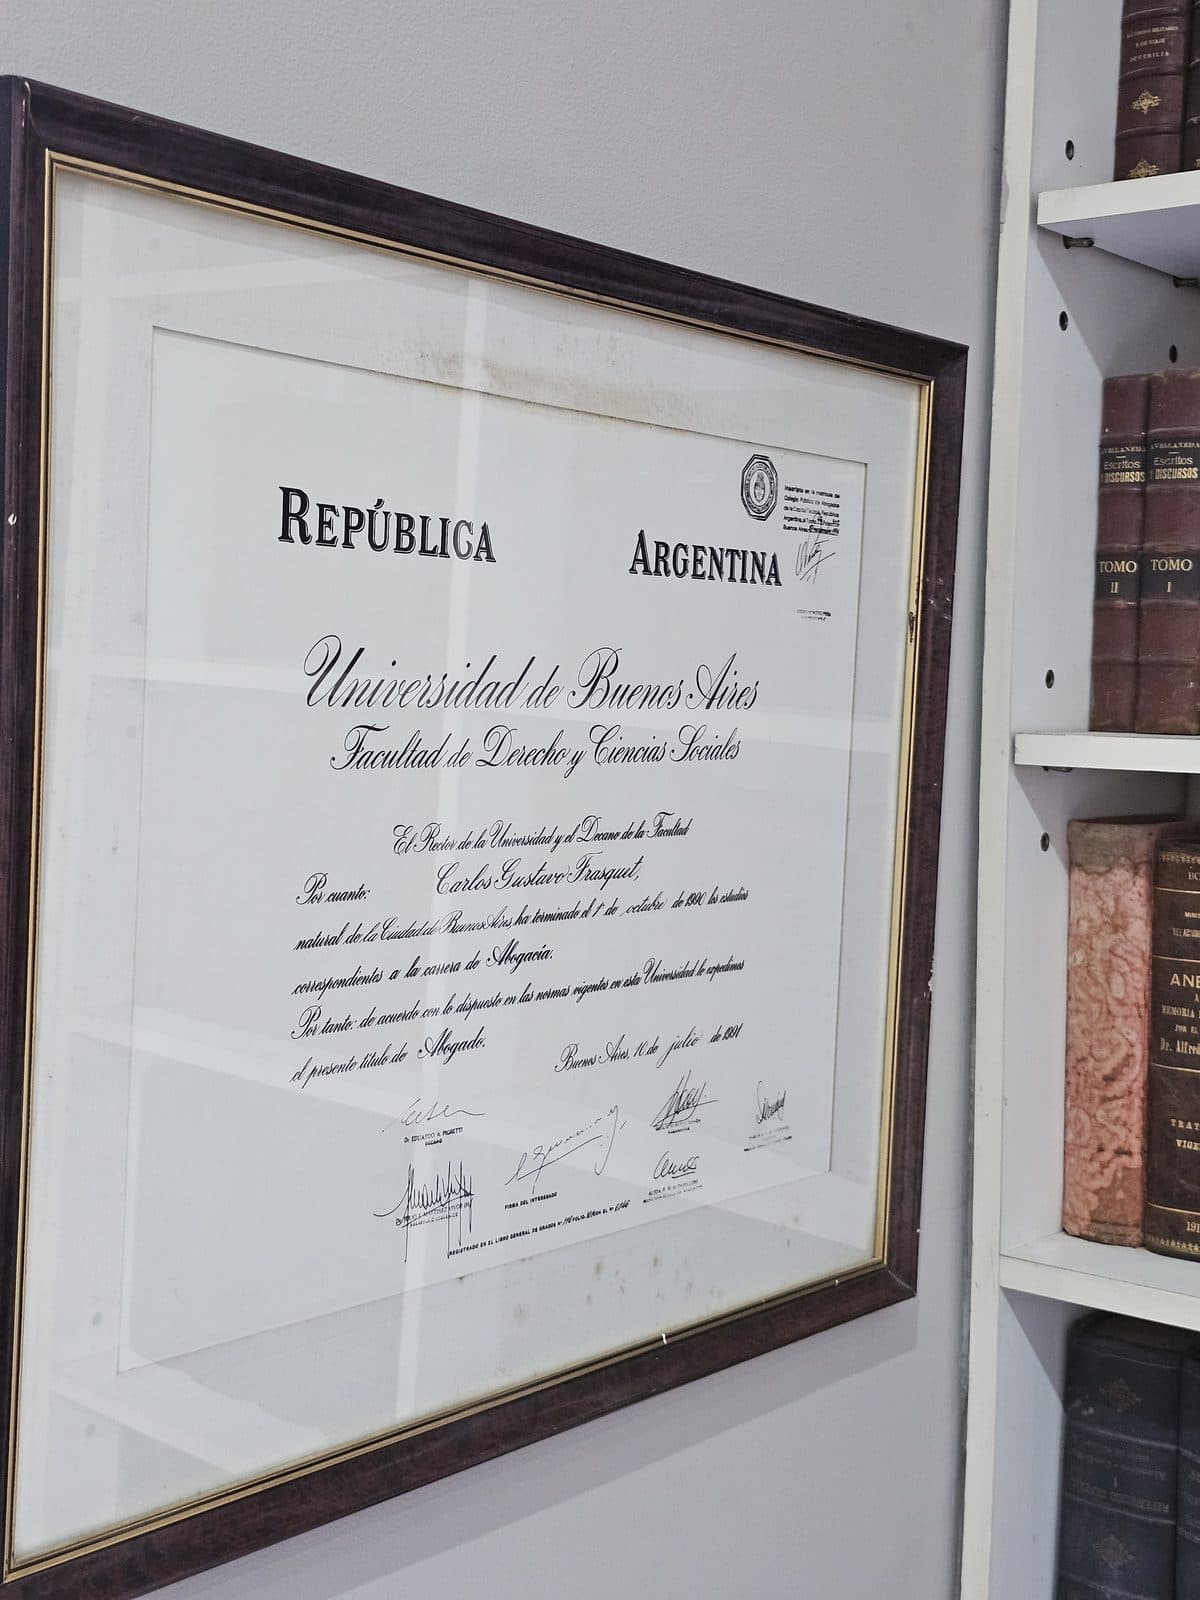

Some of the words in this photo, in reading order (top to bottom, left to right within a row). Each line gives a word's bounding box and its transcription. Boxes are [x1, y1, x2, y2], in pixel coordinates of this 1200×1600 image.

[1103, 460, 1141, 470] Escritos
[1153, 456, 1193, 466] Escritos
[1105, 471, 1145, 484] DISCURSOS
[1155, 467, 1198, 479] DISCURSOS
[278, 486, 496, 562] REPÚBLICA
[629, 529, 782, 586] ARGENTINA
[1099, 560, 1137, 573] TOMO
[1151, 558, 1193, 571] TOMO
[1111, 581, 1118, 593] II
[1167, 581, 1172, 593] I
[303, 634, 536, 709] Universidad
[520, 664, 564, 710] de
[567, 646, 682, 710] Buenos
[685, 652, 760, 711] Aires
[330, 723, 446, 771] Facultad
[443, 737, 474, 769] de
[475, 724, 570, 770] Derecho
[564, 749, 587, 778] y
[588, 723, 668, 764] Ciencias
[669, 724, 743, 763] Sociales
[392, 824, 414, 855] El
[413, 822, 456, 853] Rector
[455, 830, 474, 850] de
[472, 829, 488, 849] la
[489, 819, 558, 850] Universidad
[551, 835, 564, 853] y
[564, 823, 581, 844] el
[576, 815, 620, 844] Decano
[619, 822, 634, 841] de
[633, 820, 646, 840] la
[646, 811, 694, 839] Facultad
[296, 872, 329, 906] Por
[324, 884, 371, 904] cuanto:
[436, 862, 493, 895] Carlos
[493, 857, 569, 890] Gustavo
[566, 850, 645, 891] Frasquet,
[293, 922, 349, 951] natural
[344, 922, 365, 945] de
[361, 922, 382, 943] la
[380, 916, 429, 941] Ciudad
[420, 919, 440, 937] de
[438, 909, 487, 935] Buenos
[511, 904, 530, 927] ha
[529, 901, 581, 925] terminado
[579, 898, 597, 919] el
[603, 897, 619, 917] de
[620, 891, 666, 918] octubre
[671, 890, 685, 910] de
[707, 886, 719, 906] los
[719, 885, 749, 904] estudios
[291, 964, 384, 1001] correspondientes
[388, 967, 401, 981] a
[404, 955, 421, 980] la
[421, 961, 463, 978] carrera
[464, 950, 482, 972] de
[486, 937, 554, 975] Abogacía.
[290, 1004, 323, 1039] Por
[320, 1014, 358, 1036] tanto:
[358, 1006, 377, 1029] de
[375, 999, 421, 1026] acuerdo
[420, 1004, 442, 1019] con
[442, 992, 457, 1016] lo
[454, 991, 504, 1021] dispuesto
[503, 994, 517, 1006] en
[518, 982, 535, 1004] las
[535, 985, 571, 1002] normas
[572, 976, 609, 1004] vigentes
[609, 978, 624, 990] en
[621, 971, 642, 989] esta
[643, 957, 700, 985] Universidad
[695, 958, 708, 977] le
[706, 955, 745, 982] expedimos
[1161, 1004, 1195, 1019] MEMORIA
[554, 1043, 598, 1073] Buenos
[646, 1036, 660, 1056] de
[656, 1025, 702, 1069] julio
[709, 1024, 723, 1045] de
[1160, 1037, 1172, 1052] Dr.
[289, 1056, 312, 1082] el
[301, 1055, 358, 1089] presente
[357, 1043, 393, 1071] título
[390, 1042, 409, 1064] de
[417, 1025, 487, 1065] Abogado.
[504, 1202, 519, 1210] FIRMA
[449, 1243, 479, 1257] REGISTRADO
